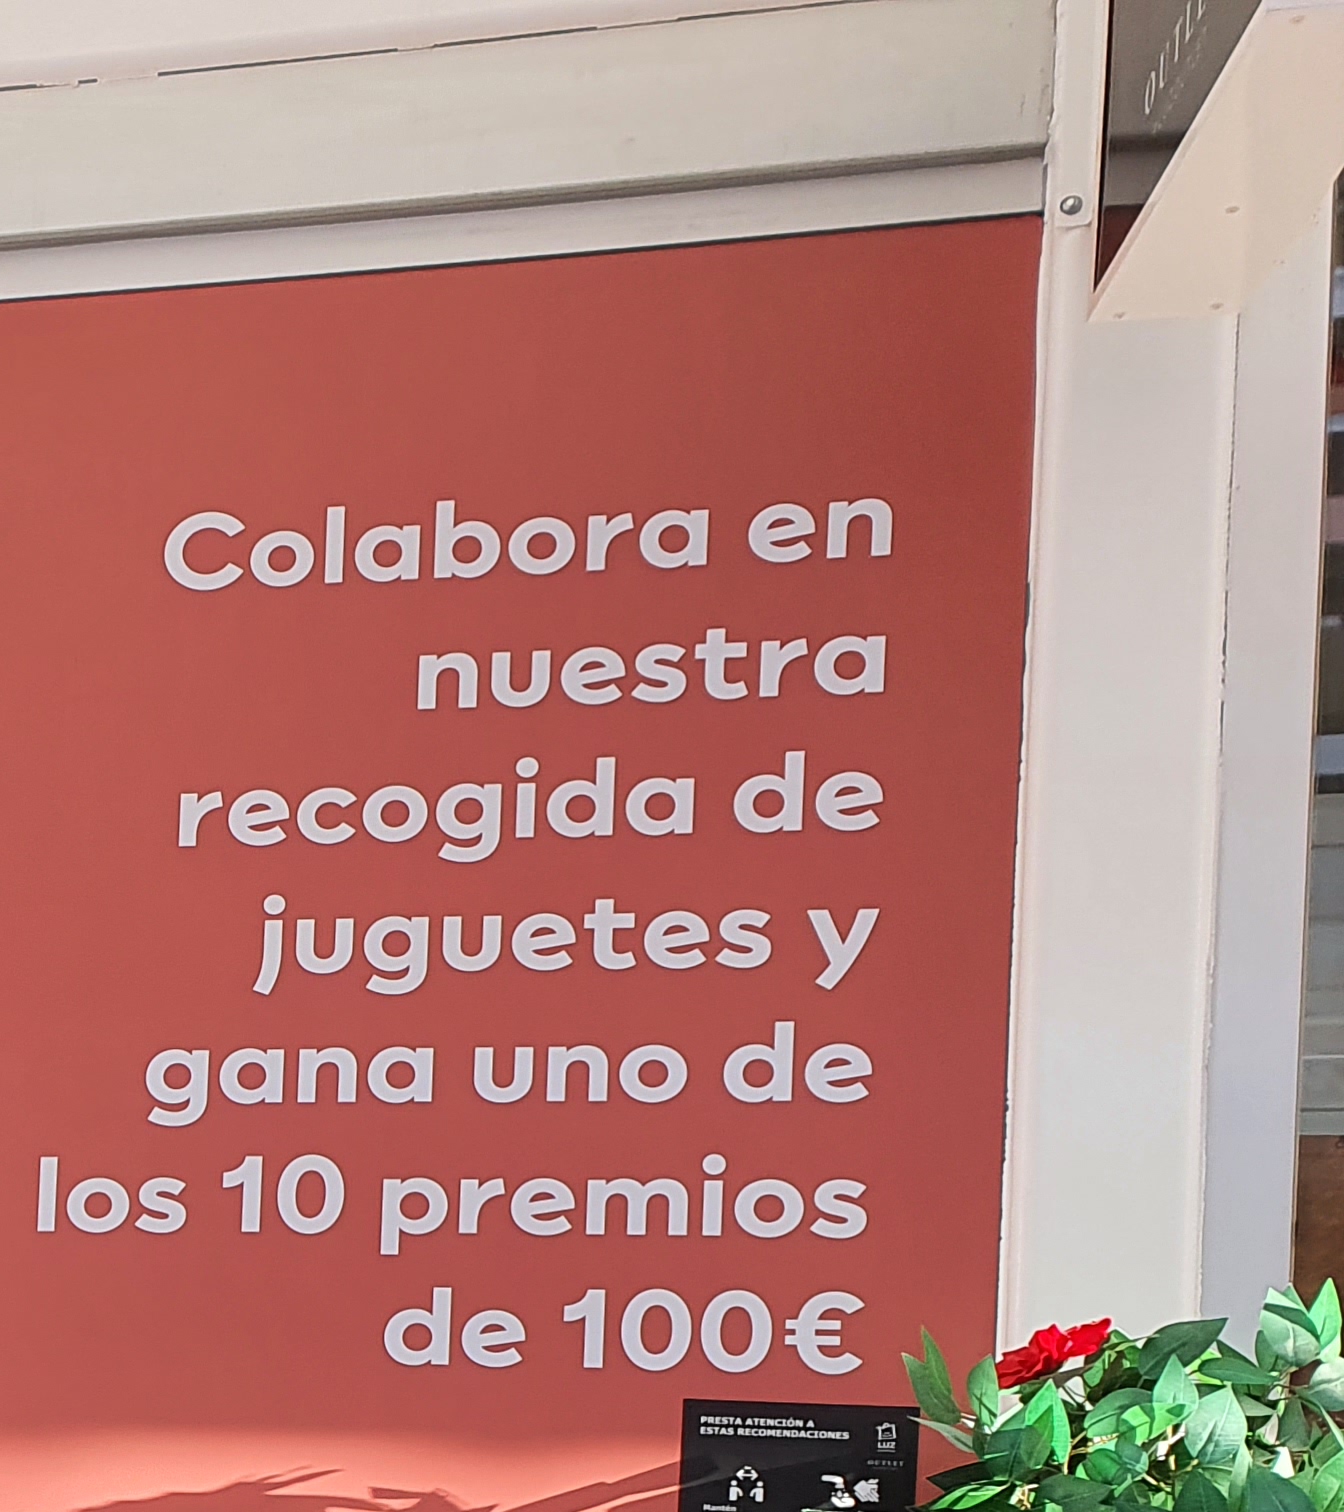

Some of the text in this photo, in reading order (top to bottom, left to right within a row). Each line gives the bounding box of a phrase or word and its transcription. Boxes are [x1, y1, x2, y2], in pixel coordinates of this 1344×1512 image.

[164, 498, 893, 591] Colabora en
[417, 628, 887, 710] nuestra
[178, 750, 884, 863] recogida de
[252, 894, 880, 996] juguetes y
[145, 1020, 873, 1127] gana uno de
[36, 1153, 868, 1256] los 10 premios
[383, 1286, 865, 1375] de 100€
[700, 1415, 815, 1428] PRESTA ATENCIÓN A
[700, 1426, 850, 1440] ESTAS RECOMENDACIONES
